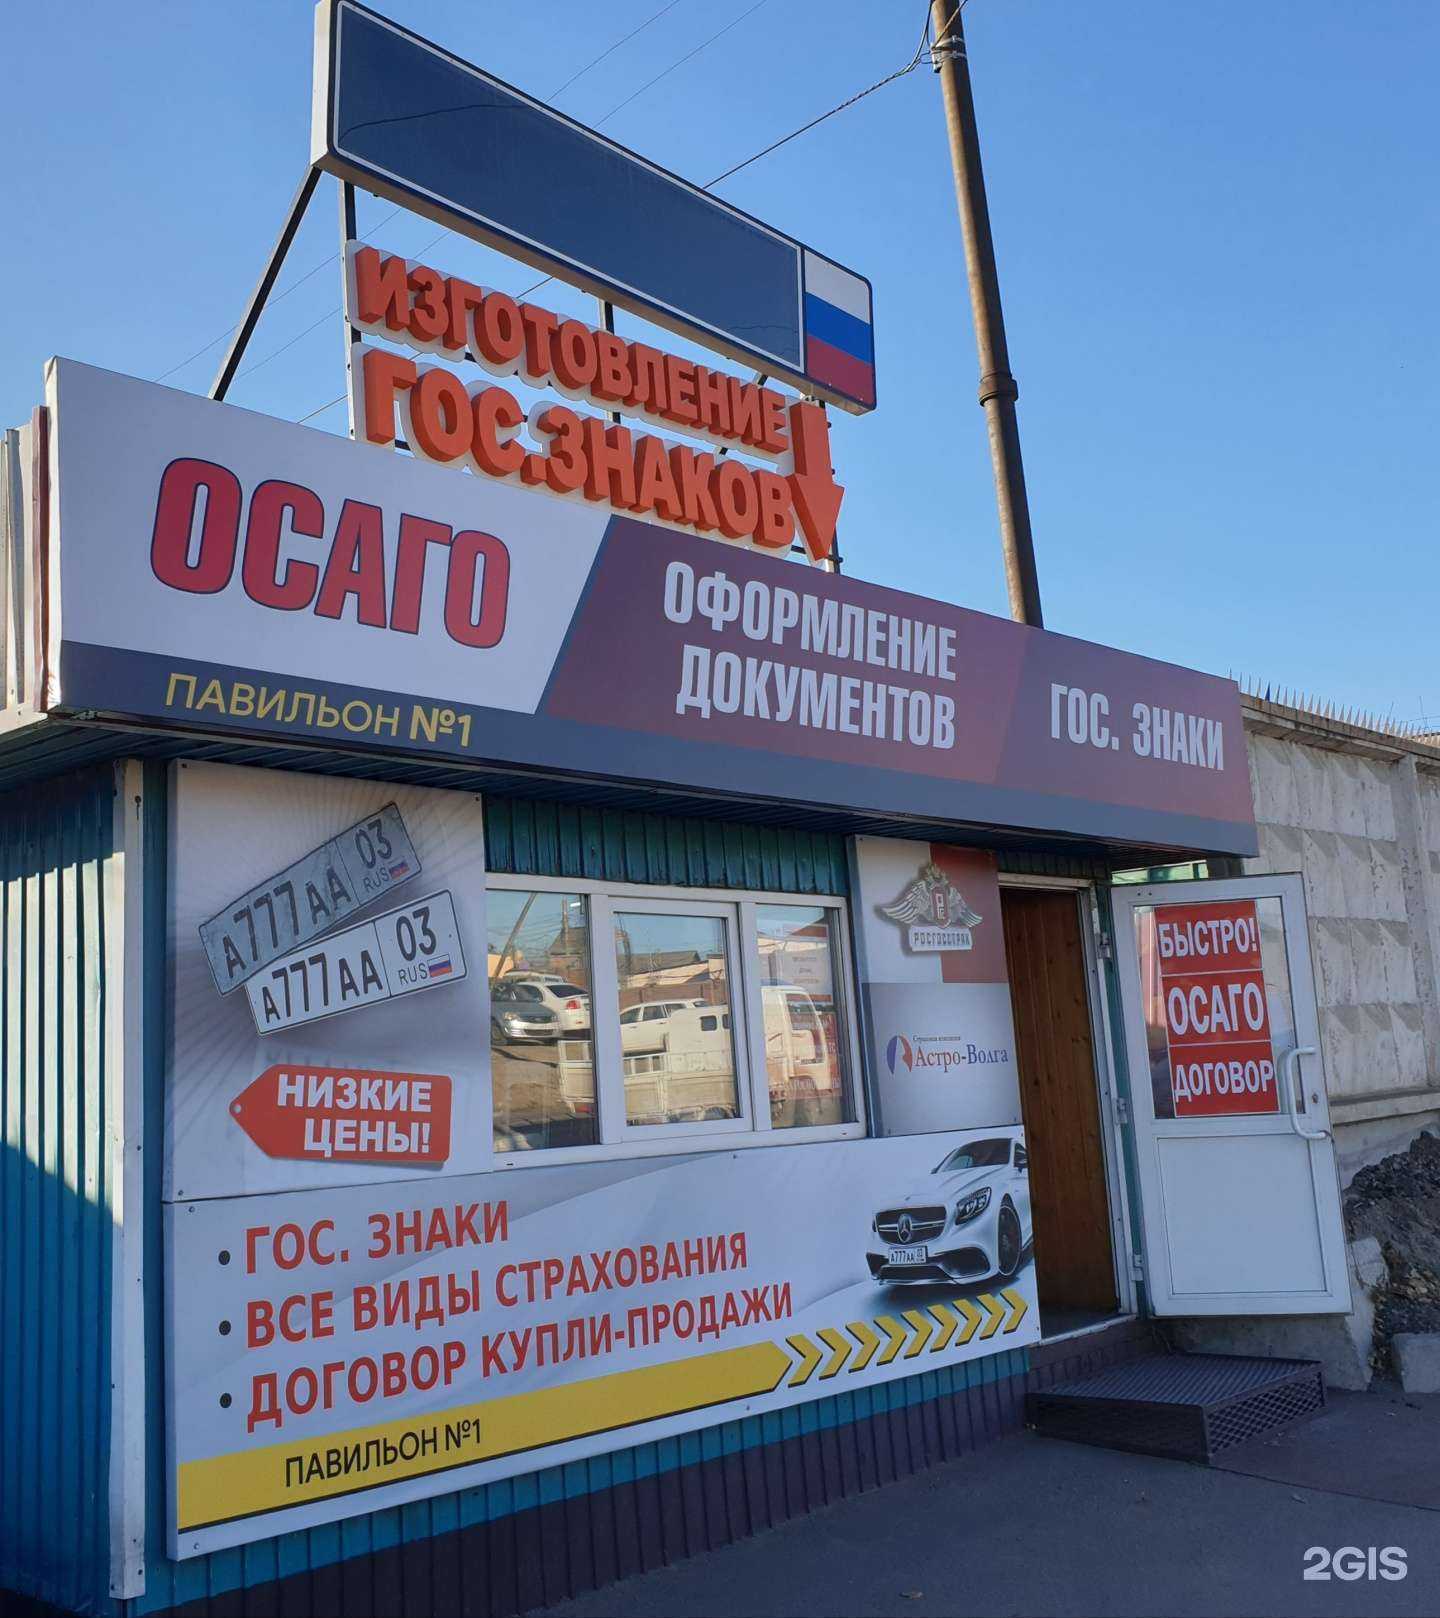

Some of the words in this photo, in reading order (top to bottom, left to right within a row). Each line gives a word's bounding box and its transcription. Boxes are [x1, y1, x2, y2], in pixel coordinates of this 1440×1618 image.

[355, 246, 788, 453] ИЗГОТОВЛЕНИЕ
[363, 349, 795, 548] ГОС.ЗНАКОВ
[150, 457, 510, 648] ОСАГО
[664, 561, 956, 681] ОФОРМЛЕНИЕ
[165, 673, 399, 738] ПАВИЛЬОН
[409, 708, 472, 747] №1
[676, 644, 955, 750] ДОКУМЕНТОВ
[1050, 683, 1119, 751] ГОС.
[1132, 702, 1224, 770] ЗНАКИ
[355, 819, 392, 869] 03
[363, 868, 390, 893] RUS
[396, 907, 437, 961] 03
[1158, 918, 1258, 958] БЫСТРО!
[398, 962, 428, 986] RUS
[1168, 982, 1264, 1036] ОСАГО
[277, 1073, 432, 1113] НИЗКИЕ
[915, 1044, 1009, 1073] Астро-Волга
[1174, 1060, 1274, 1102] ДОГОВОР
[303, 1118, 430, 1158] ЦЕНЫ!
[246, 1219, 350, 1275] ГОС.
[368, 1201, 509, 1258] ЗНАКИ
[247, 1291, 335, 1348] ВСЕ
[353, 1270, 480, 1331] ВИДЫ
[495, 1232, 748, 1305] СТРАХОВАНИЯ
[247, 1340, 466, 1433] ДОГОВОР
[482, 1282, 792, 1377] КУПЛИ-ПРОДАЖИ
[285, 1427, 438, 1487] ПАВИЛЬОН
[445, 1418, 482, 1451] №1
